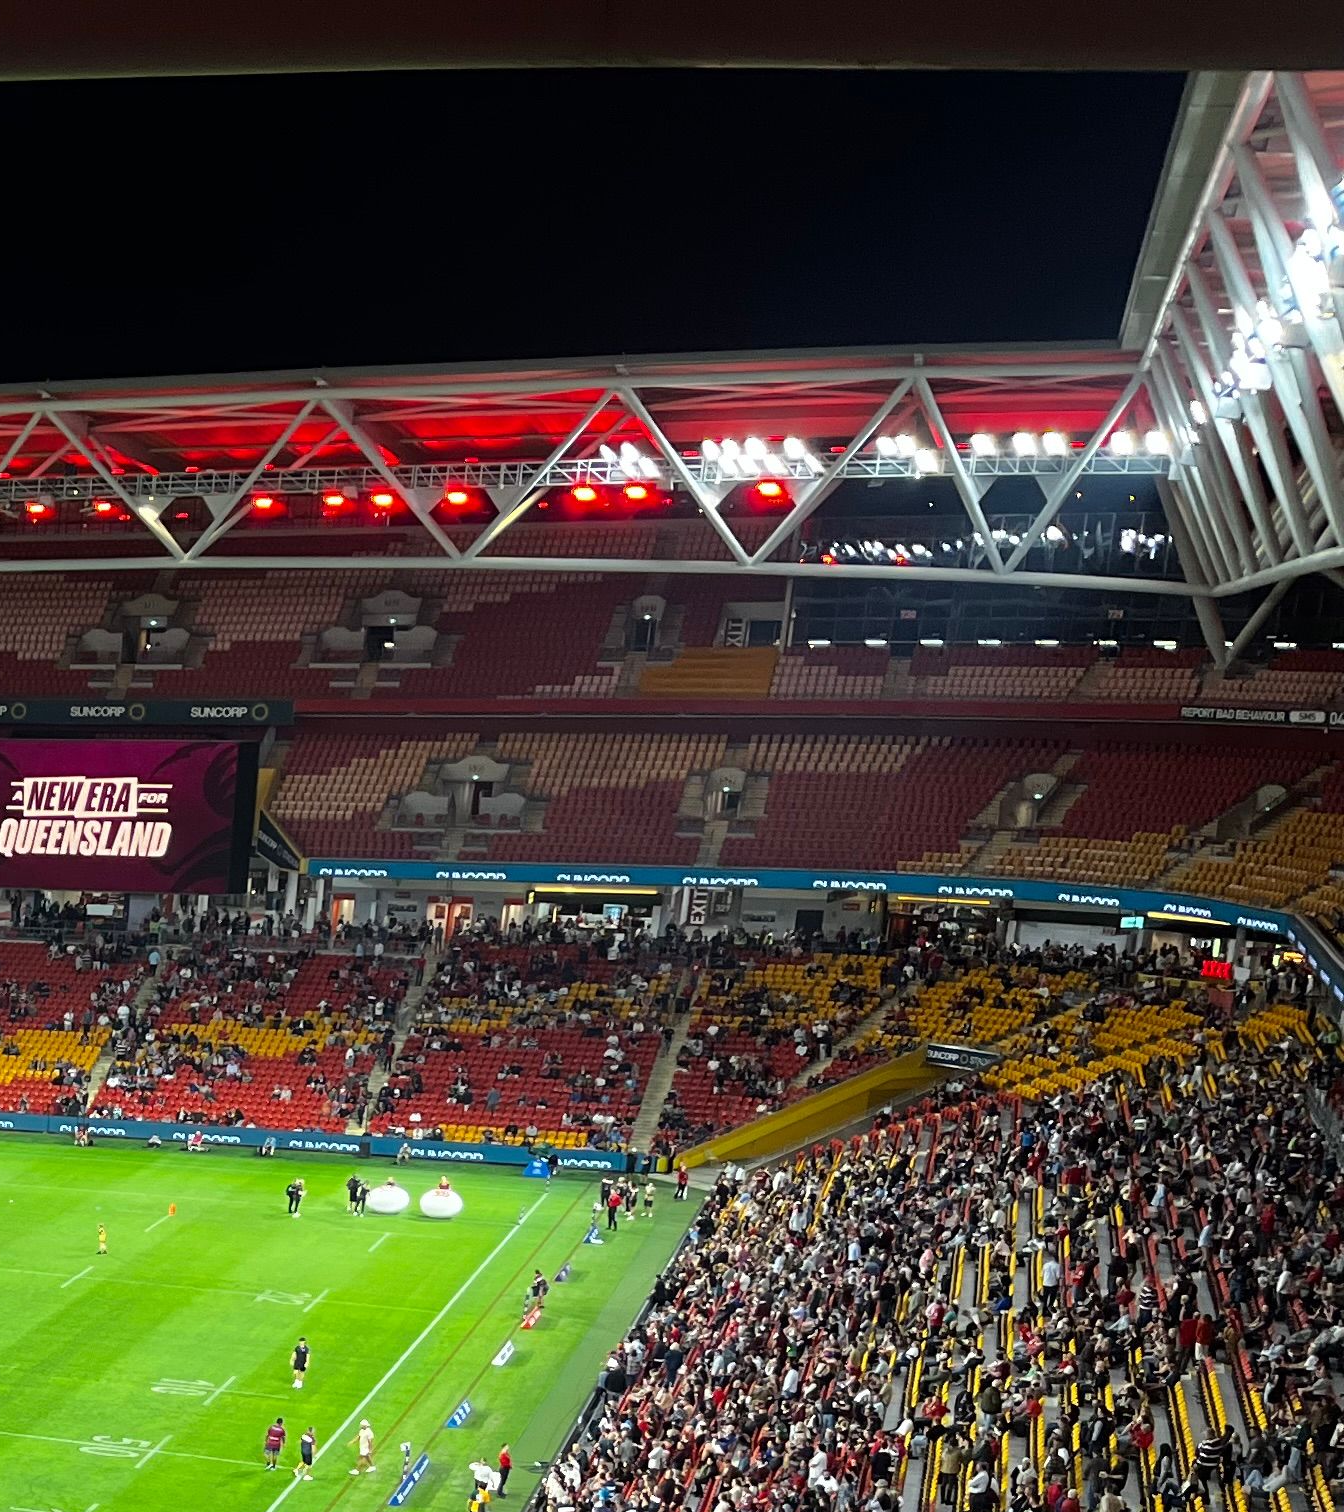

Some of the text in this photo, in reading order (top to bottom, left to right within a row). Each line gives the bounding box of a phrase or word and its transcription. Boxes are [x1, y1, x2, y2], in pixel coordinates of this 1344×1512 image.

[70, 706, 125, 717] SUNCORP
[190, 706, 248, 718] SUNCORP
[1181, 707, 1215, 718] REPORT
[1216, 709, 1235, 719] BAD
[1235, 710, 1285, 722] BEHAVIOUR
[12, 781, 168, 812] A NEW ERA FOR
[690, 888, 708, 925] EXIT
